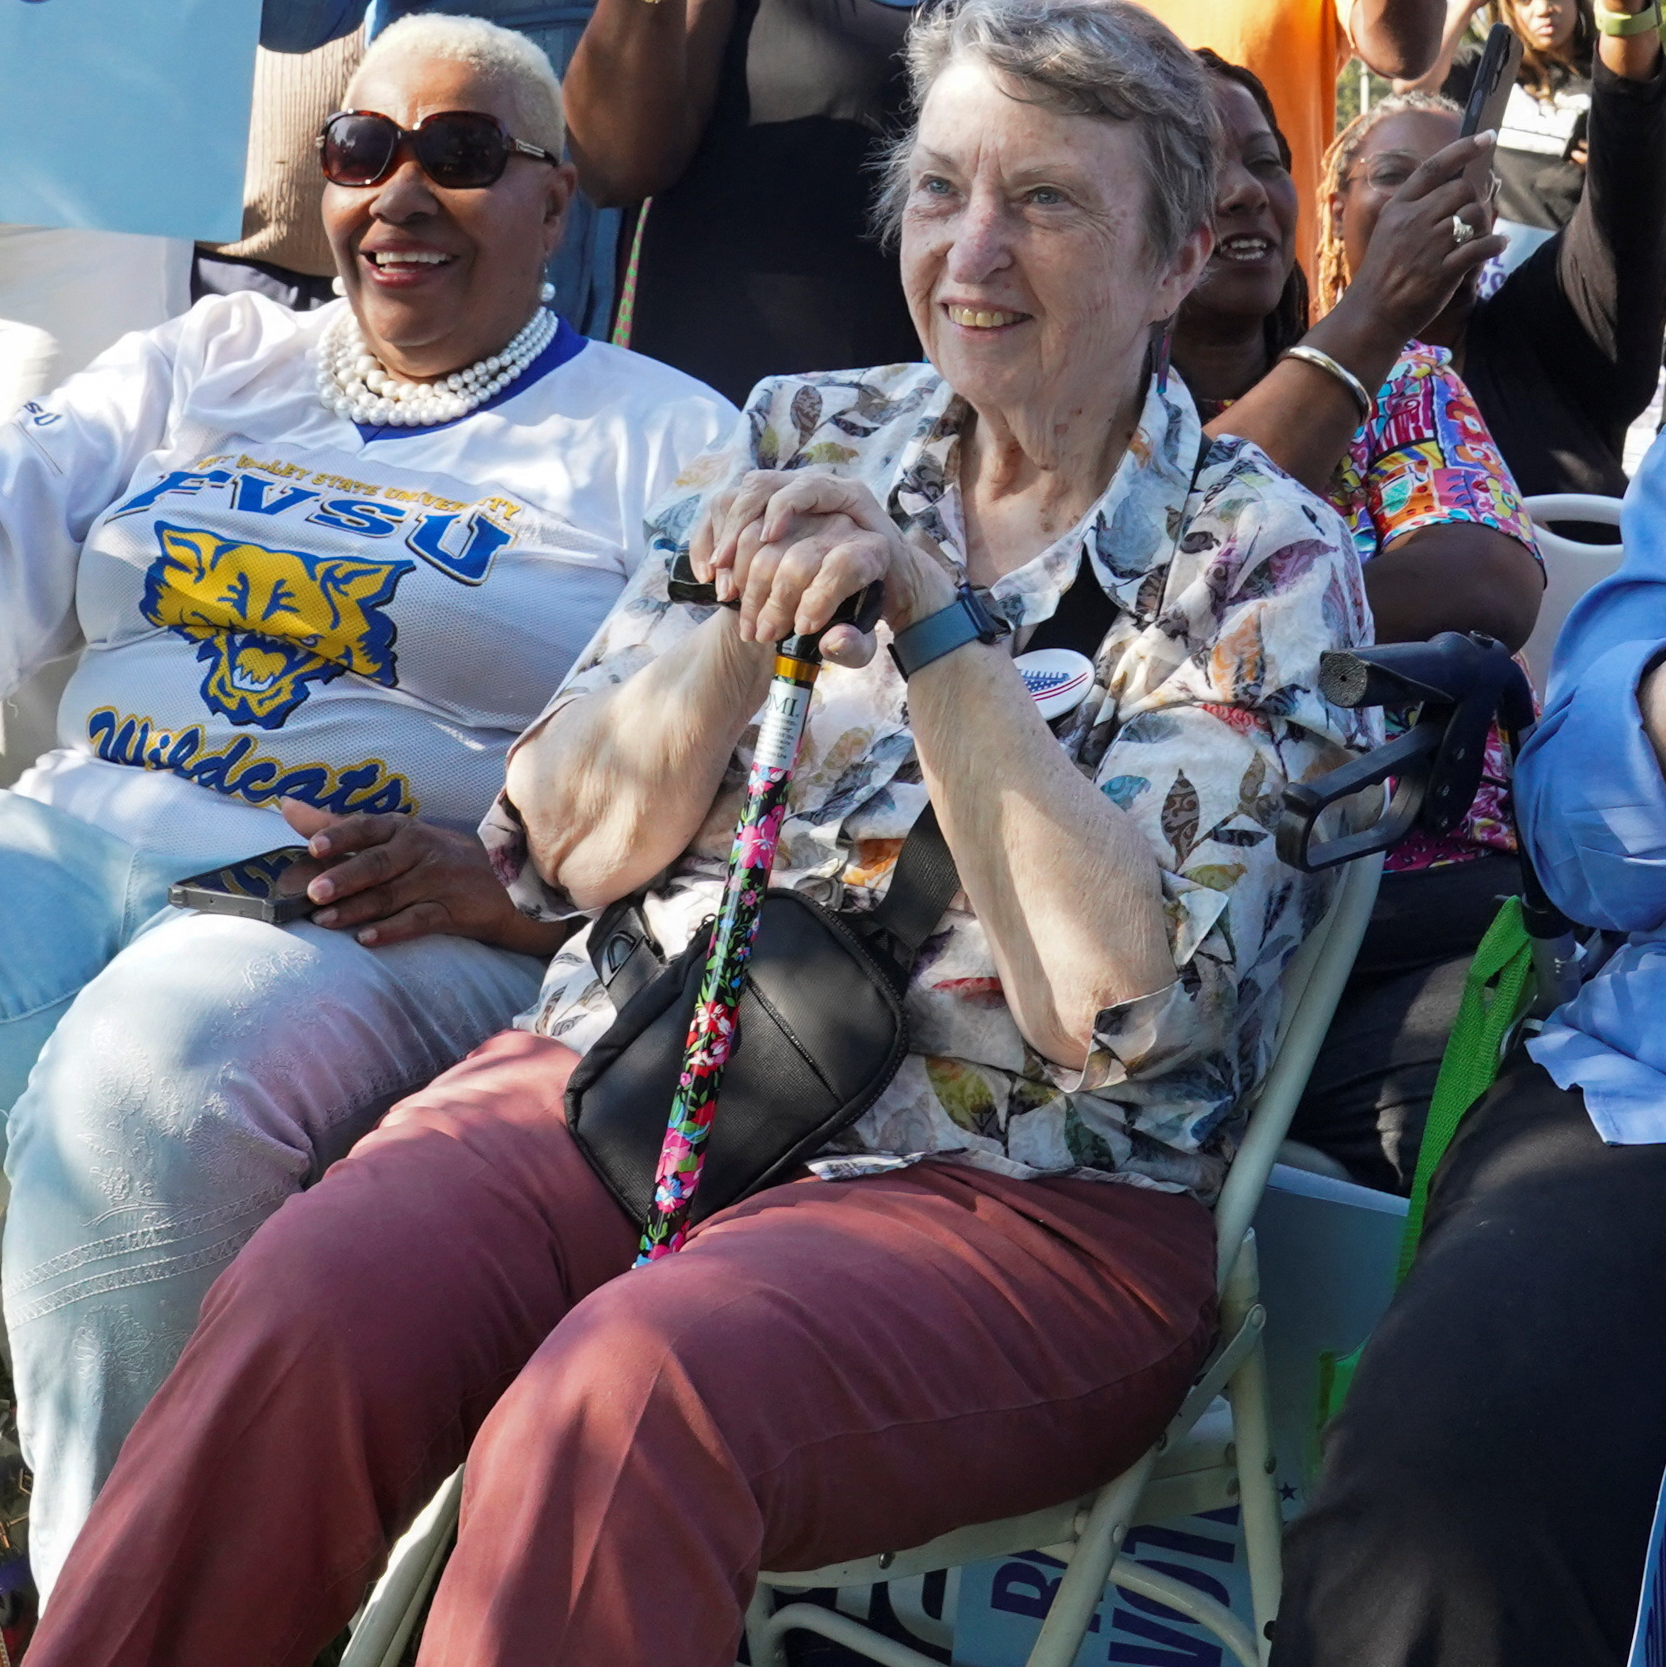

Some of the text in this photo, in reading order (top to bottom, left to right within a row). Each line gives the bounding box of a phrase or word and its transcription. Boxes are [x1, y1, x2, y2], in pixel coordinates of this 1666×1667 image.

[22, 400, 63, 427] SU
[311, 472, 383, 497] STATE
[105, 469, 519, 587] FVSU
[86, 705, 420, 818] Wildcats
